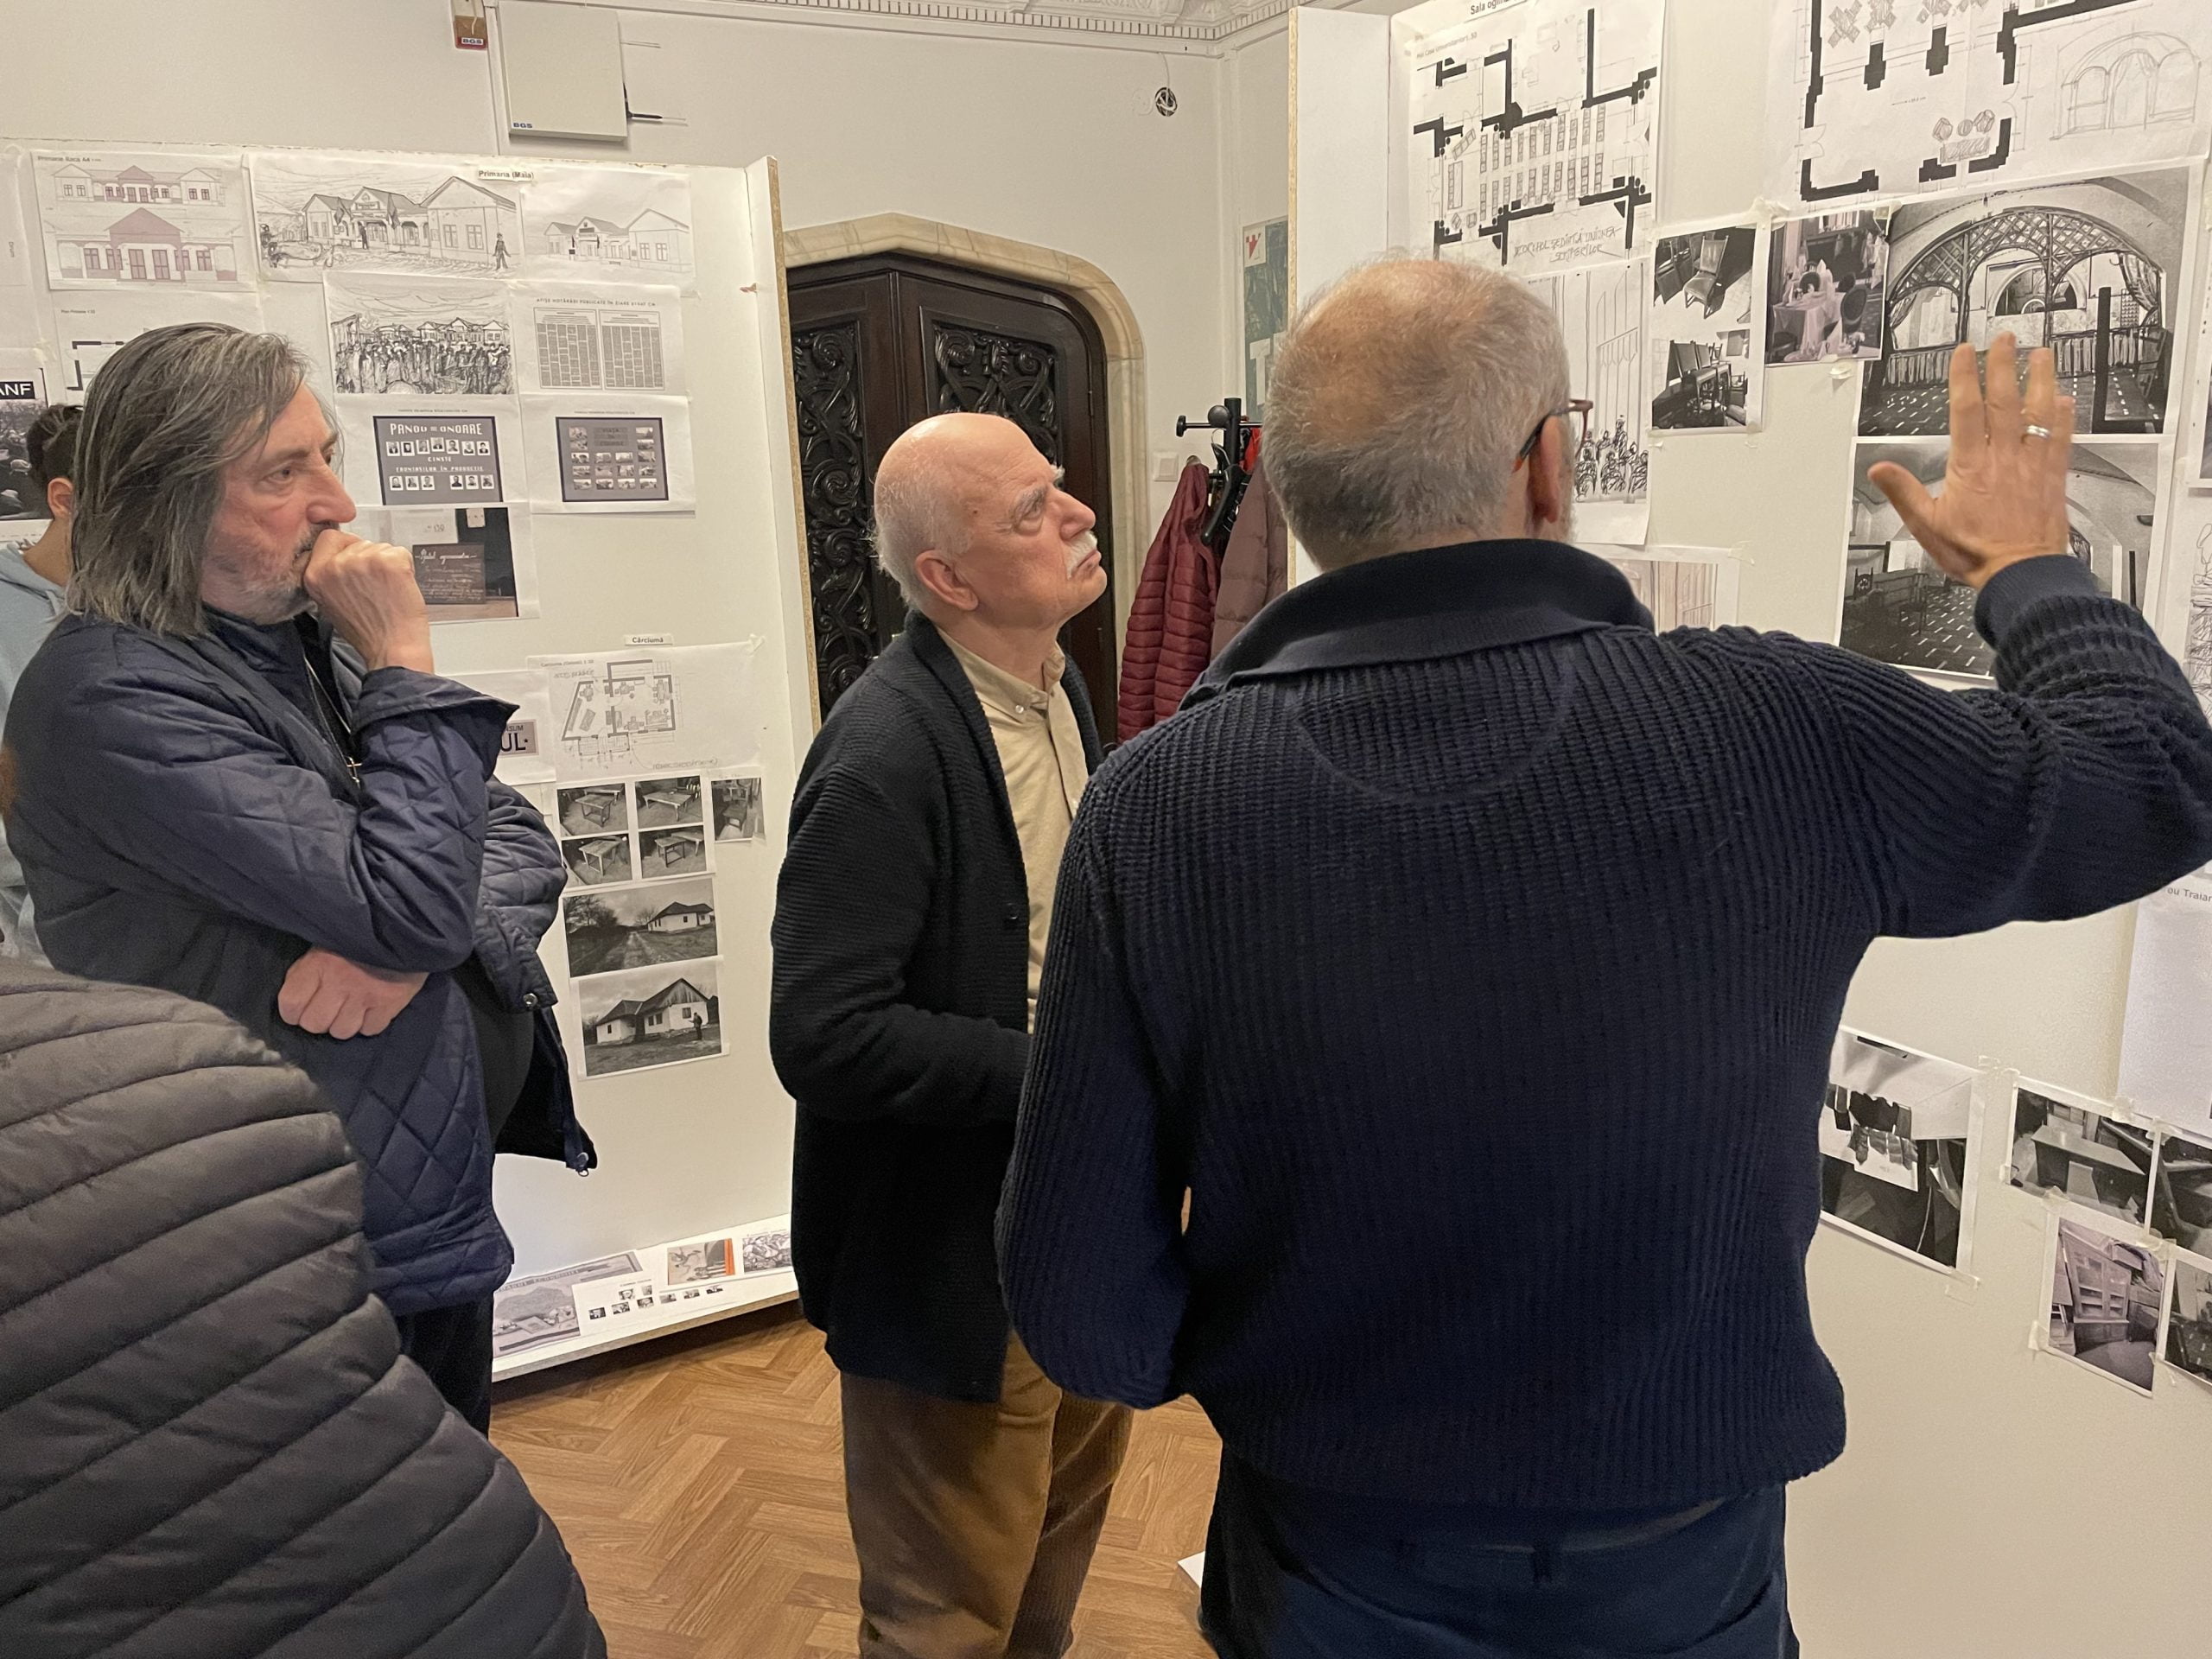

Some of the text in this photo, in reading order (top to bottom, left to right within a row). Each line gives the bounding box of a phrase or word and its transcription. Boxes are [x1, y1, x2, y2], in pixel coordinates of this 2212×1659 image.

[1471, 2, 1485, 15] Sala
[391, 423, 428, 435] PANOU
[440, 423, 483, 435] ONOARE
